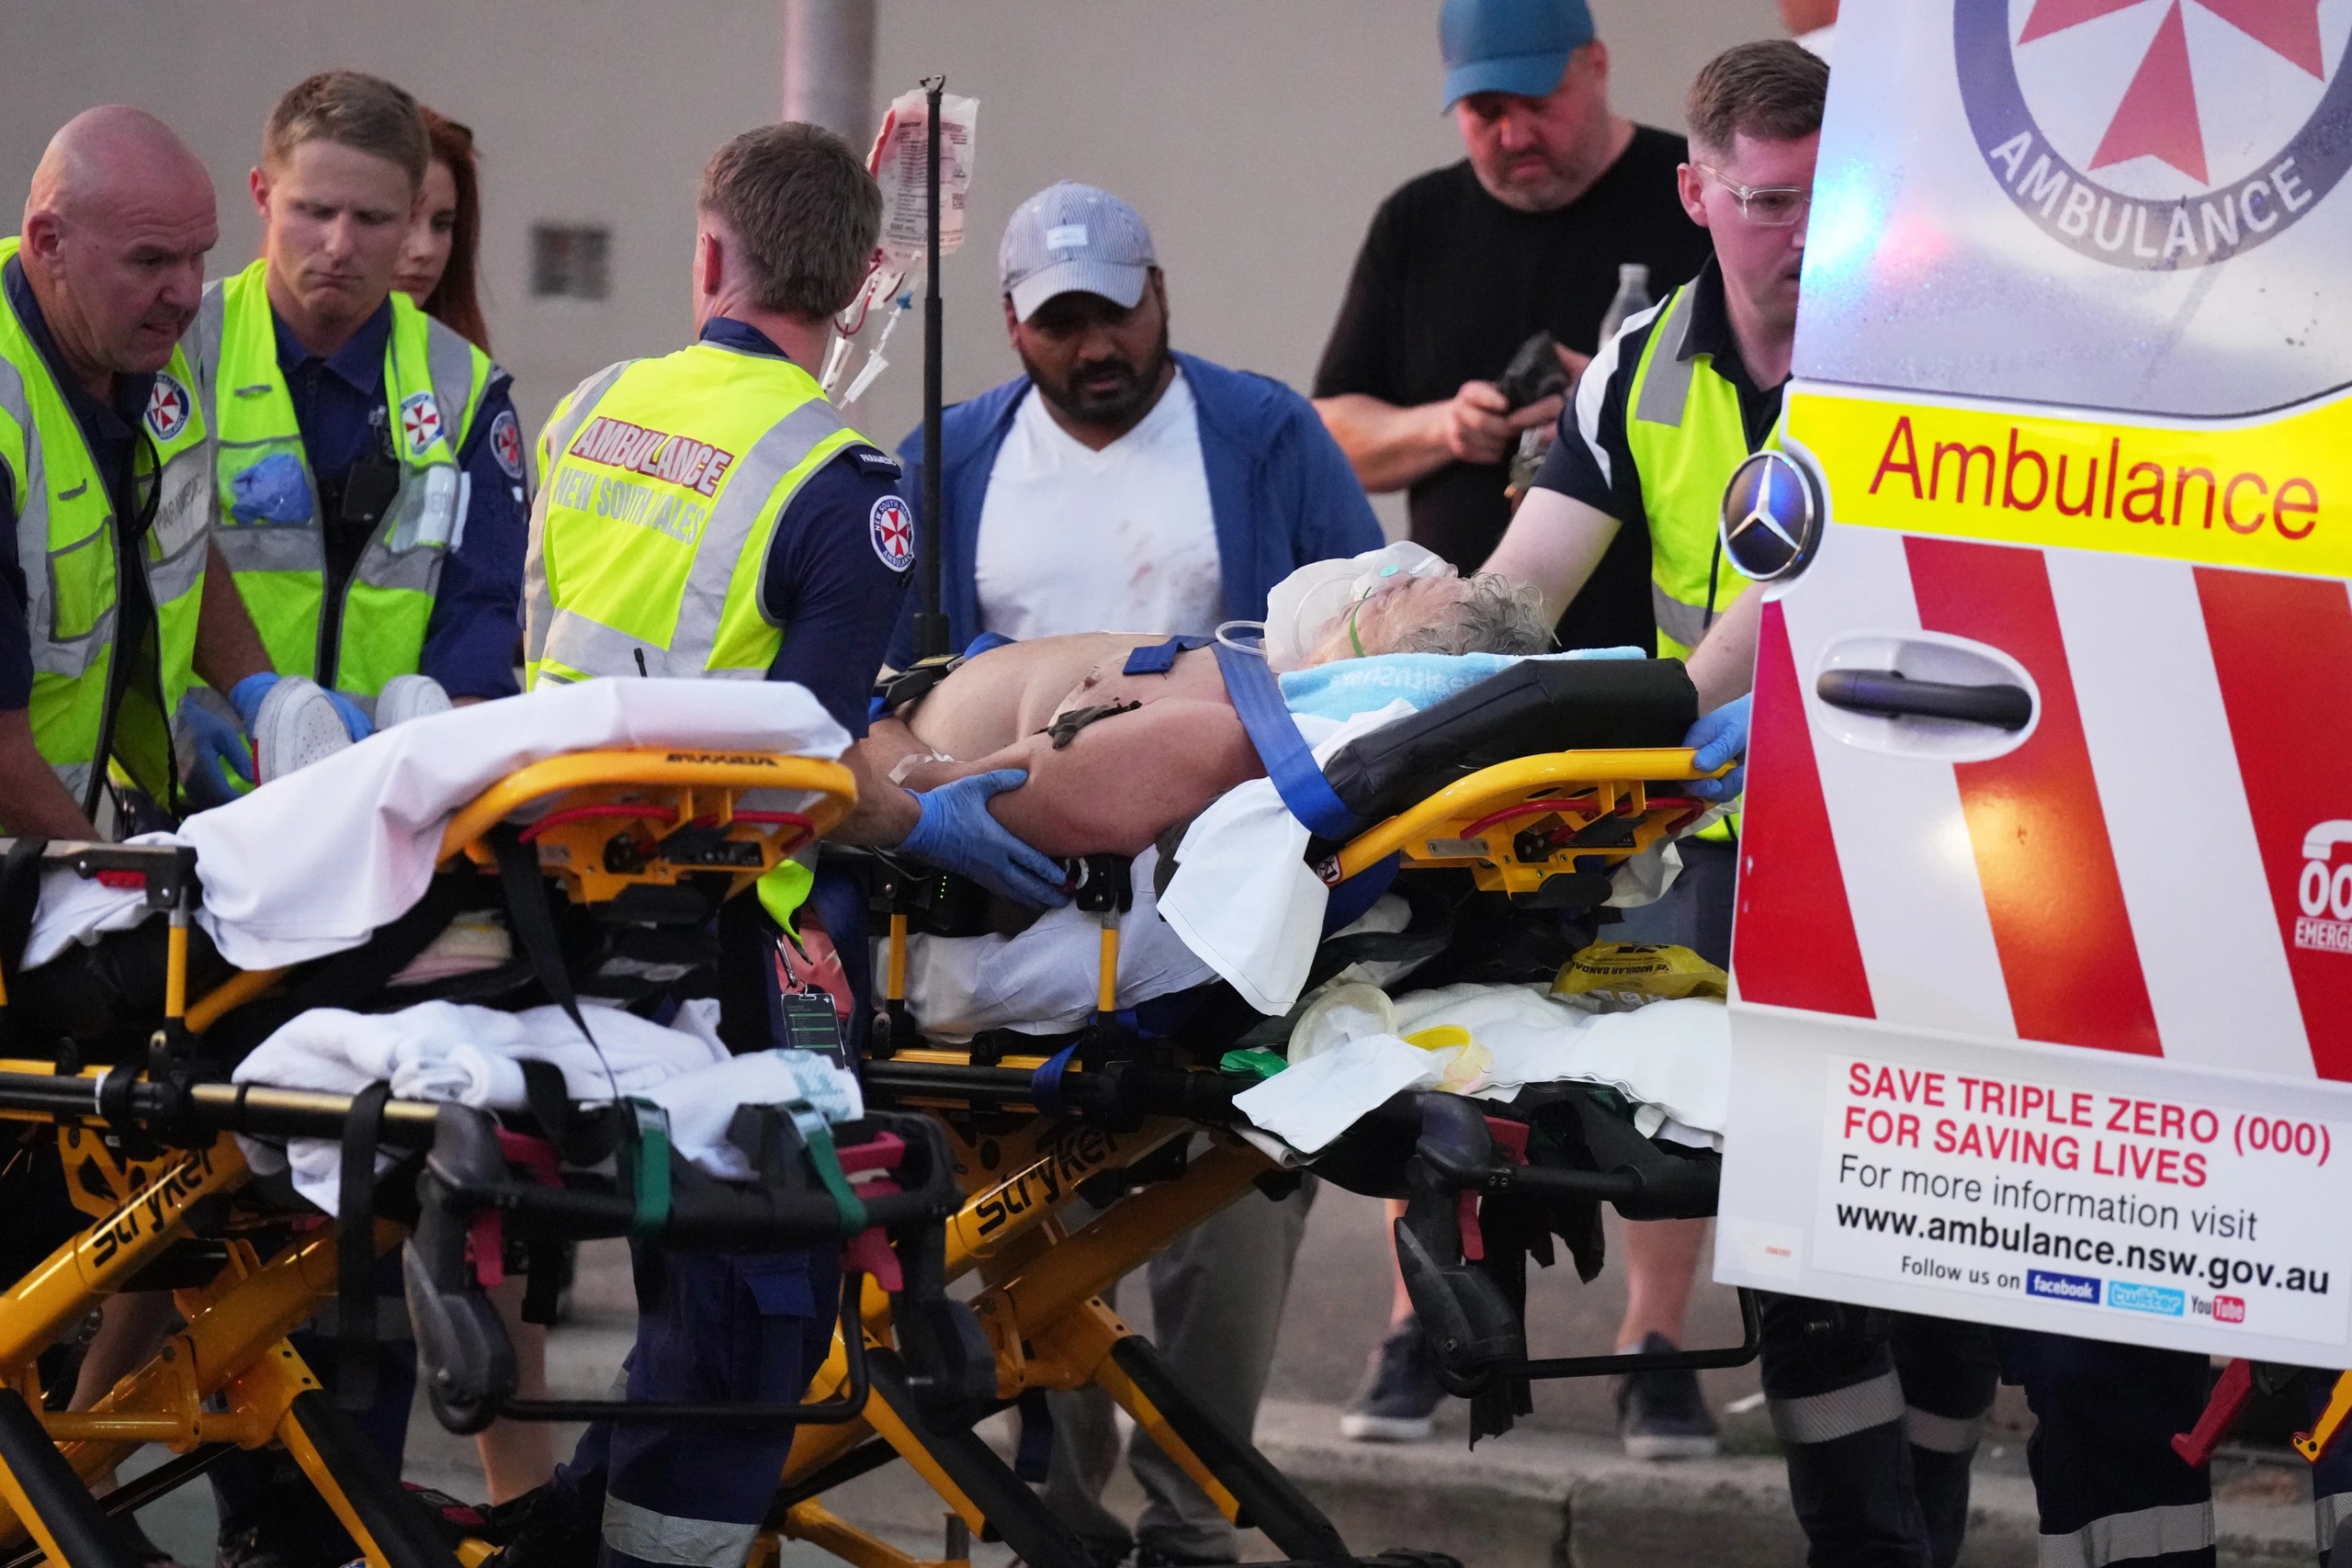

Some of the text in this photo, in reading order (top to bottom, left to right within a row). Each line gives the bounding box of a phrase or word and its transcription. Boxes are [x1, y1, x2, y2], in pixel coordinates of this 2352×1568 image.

[1989, 130, 2313, 259] AMBULANCE
[552, 466, 598, 512] NEW
[597, 477, 654, 527] SOUTH
[569, 415, 736, 499] AMBULANCE
[1869, 415, 2321, 541] Ambulance
[1611, 964, 1654, 976] MODULAR
[2296, 920, 2352, 951] EMERG
[1844, 1105, 2208, 1188] FOR SAVING LIVES
[1848, 1061, 2331, 1168] SAVE TRIPLE ZERO (000)
[1839, 1153, 2258, 1241] For more information visit
[1837, 1202, 2329, 1295] www.ambulance.nsw.gov.au
[1901, 1256, 1962, 1281] Follow
[1969, 1269, 1990, 1287] us
[1996, 1272, 2021, 1291] on
[2032, 1274, 2095, 1300] facebook
[2112, 1282, 2181, 1313] twitter
